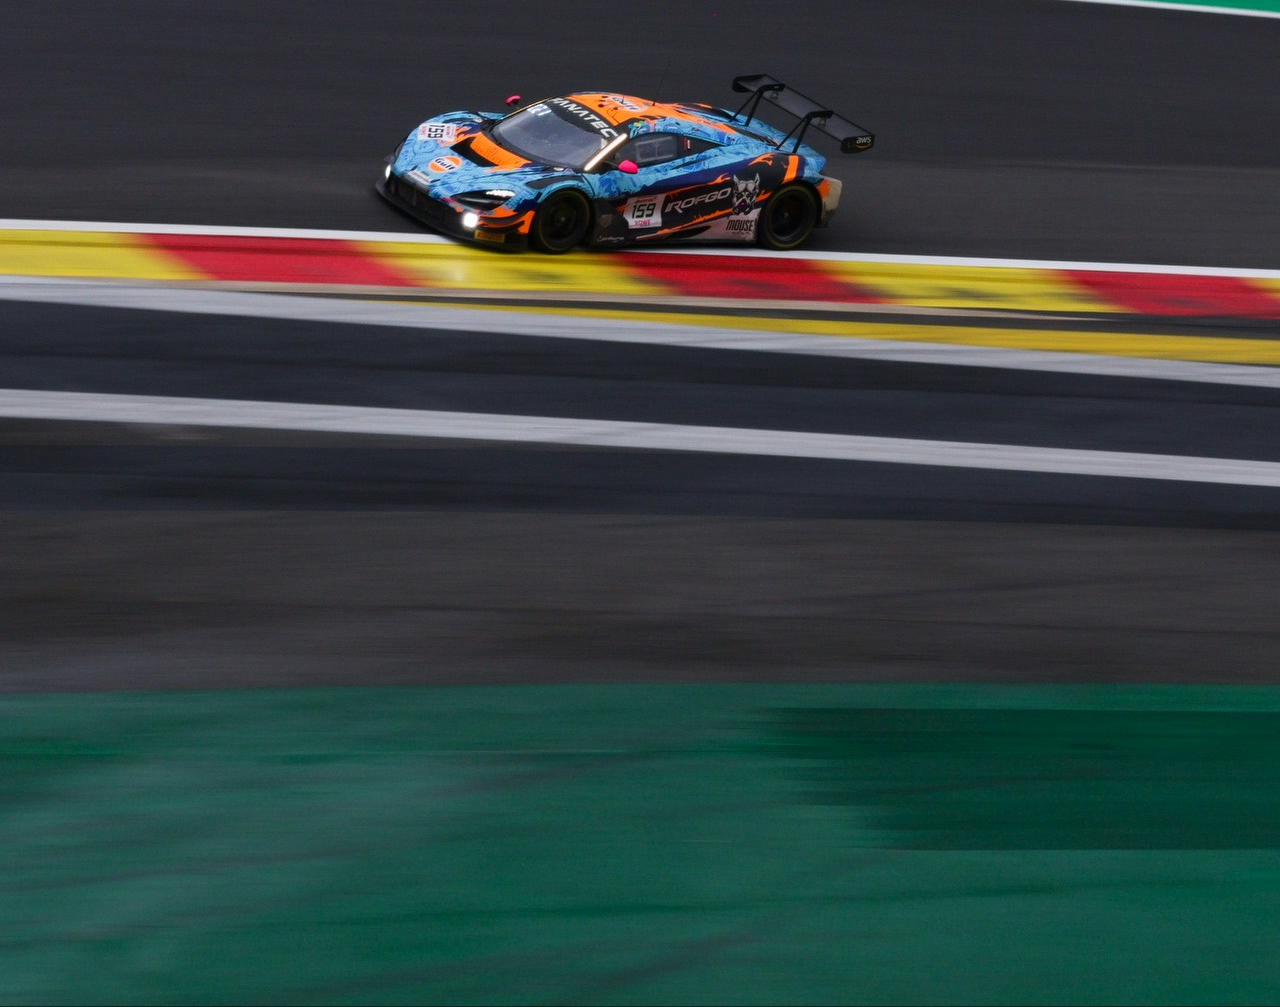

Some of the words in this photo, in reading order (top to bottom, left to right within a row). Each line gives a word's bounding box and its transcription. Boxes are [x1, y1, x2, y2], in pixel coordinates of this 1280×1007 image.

[551, 97, 619, 138] FANATEC
[427, 124, 445, 139] 159
[856, 136, 872, 144] aws
[434, 157, 455, 171] Gulf
[665, 187, 732, 214] ROFGO
[631, 202, 657, 219] 159
[725, 219, 754, 232] MOUSE
